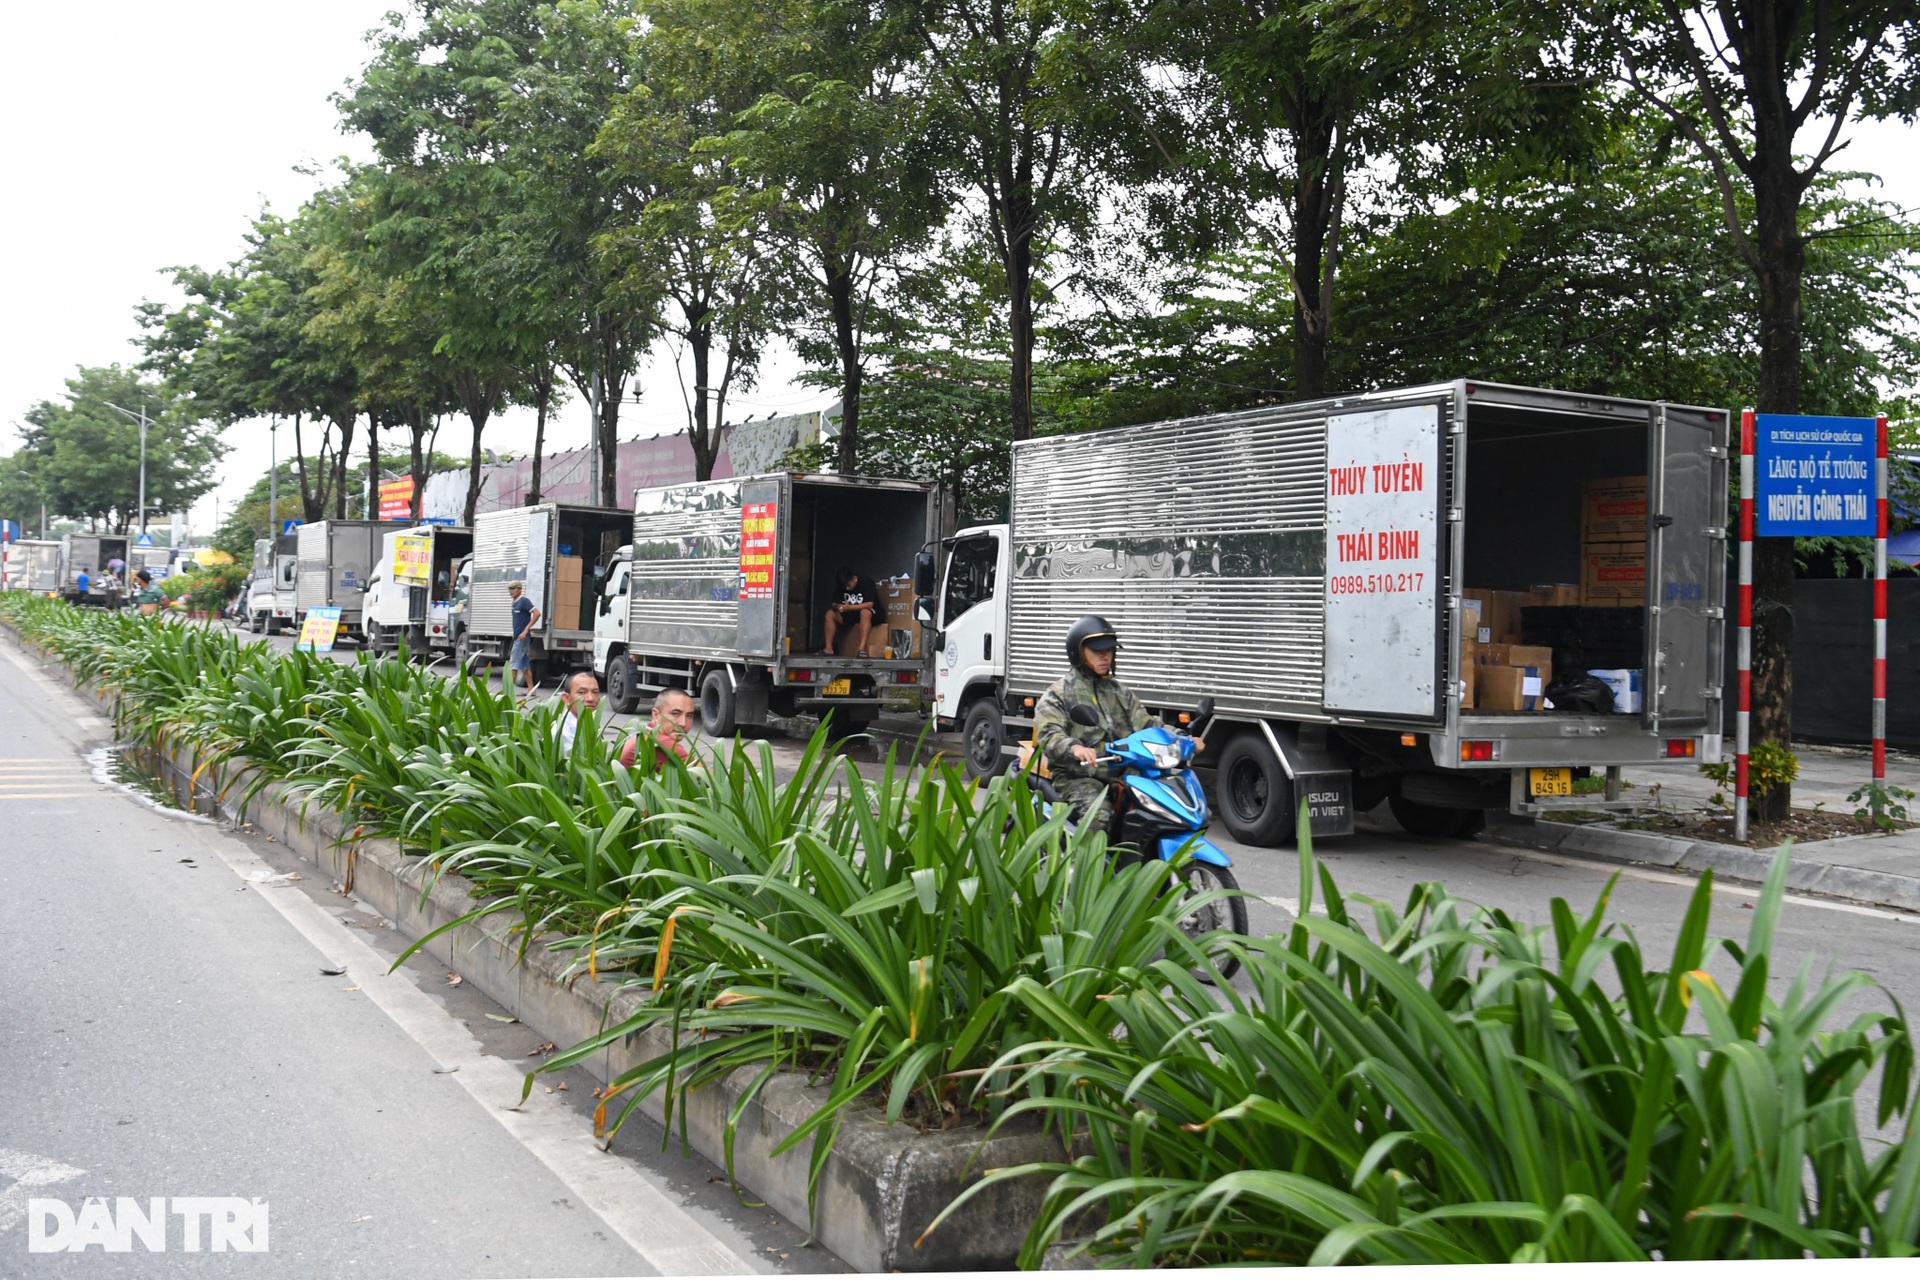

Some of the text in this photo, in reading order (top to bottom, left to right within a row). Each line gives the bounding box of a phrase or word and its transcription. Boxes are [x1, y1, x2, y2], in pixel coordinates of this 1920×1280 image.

[1768, 450, 1868, 483] LĂNG MỘ TỂ TƯỚNG
[1329, 459, 1367, 496] THÚY
[1767, 485, 1868, 521] NGUYỄN CÔNG THÁI
[1336, 524, 1419, 562] THÁI BÌNH
[1330, 572, 1424, 595] 0989.510.217
[843, 592, 864, 605] D&G
[1542, 768, 1560, 781] 29H
[1535, 781, 1568, 794] 849.16
[1308, 791, 1339, 803] ISUZU
[1321, 805, 1345, 817] VIET
